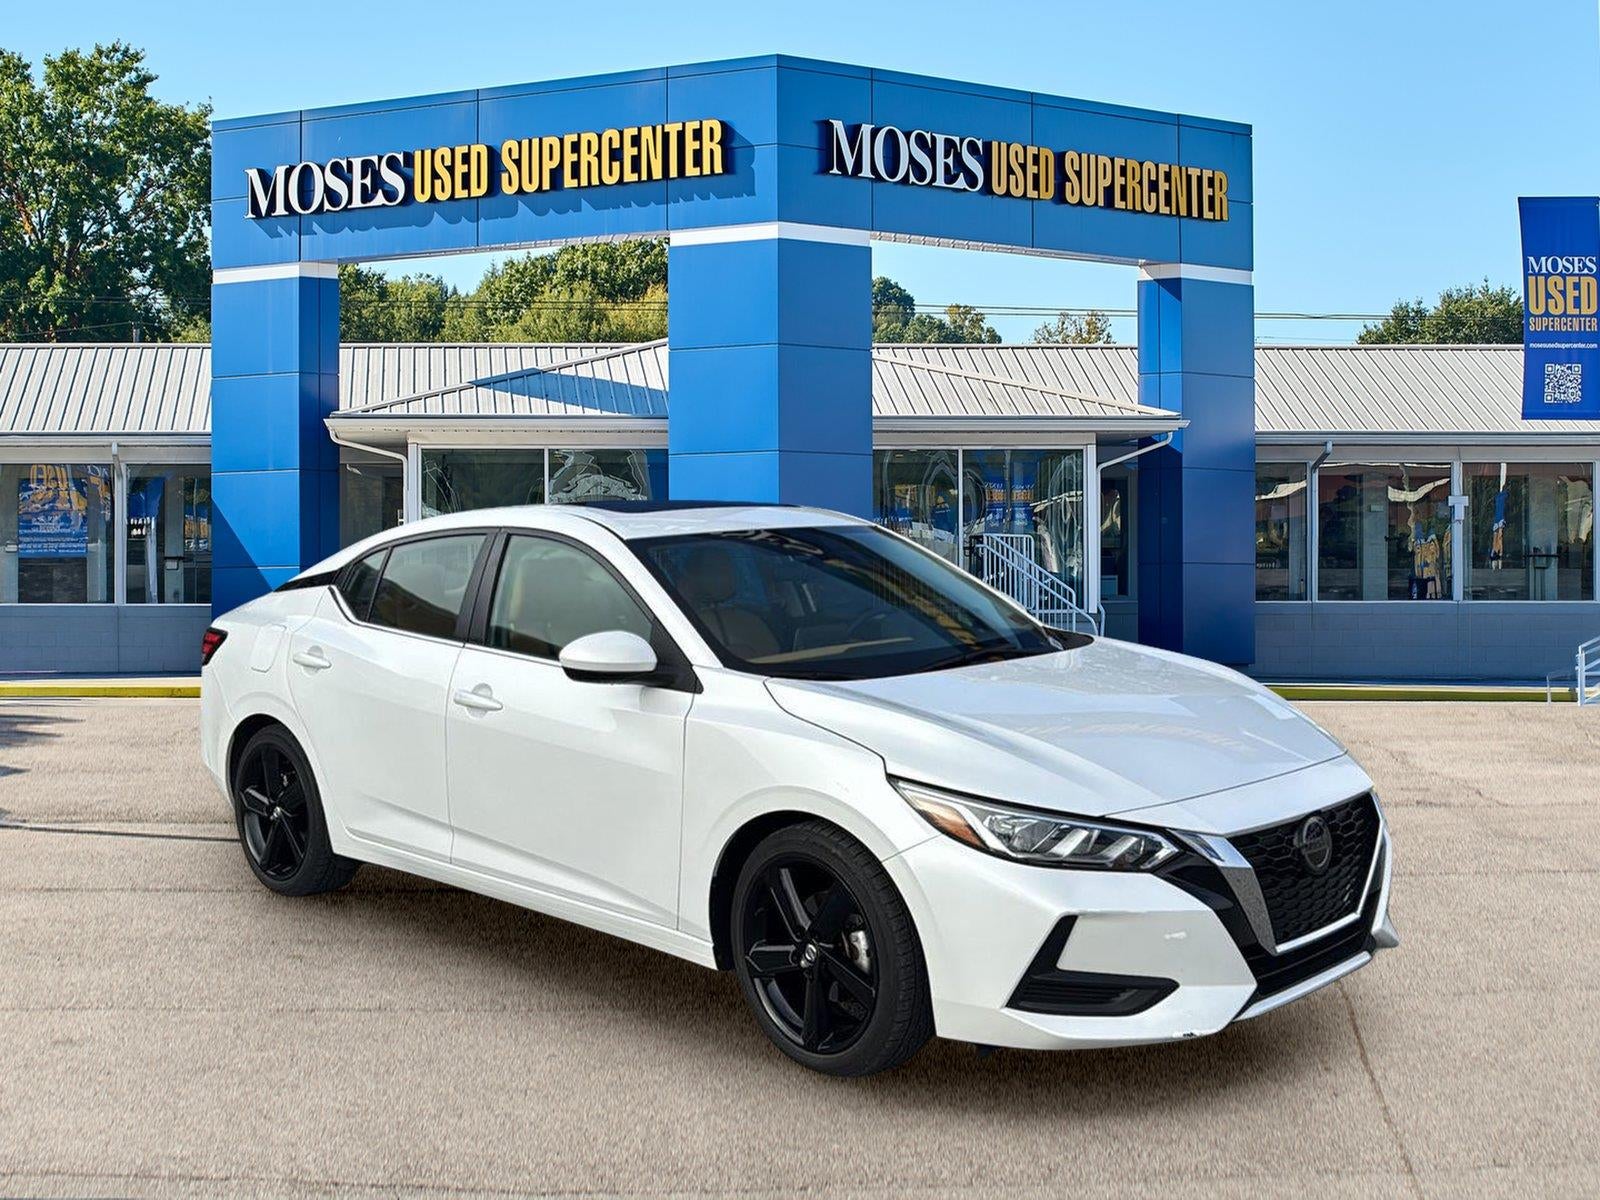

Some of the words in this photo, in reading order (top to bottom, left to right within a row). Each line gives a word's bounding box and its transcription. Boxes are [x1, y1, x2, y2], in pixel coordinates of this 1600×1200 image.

[245, 153, 405, 219] MOSES
[413, 143, 489, 203] USED
[500, 119, 723, 195] SUPERCENTER
[828, 119, 985, 192] MOSES
[990, 140, 1055, 201] USED
[1064, 151, 1229, 221] SUPERCENTER
[1527, 256, 1597, 274] MOSES
[1528, 275, 1598, 315] USED
[1529, 317, 1598, 332] SUPERCENTER
